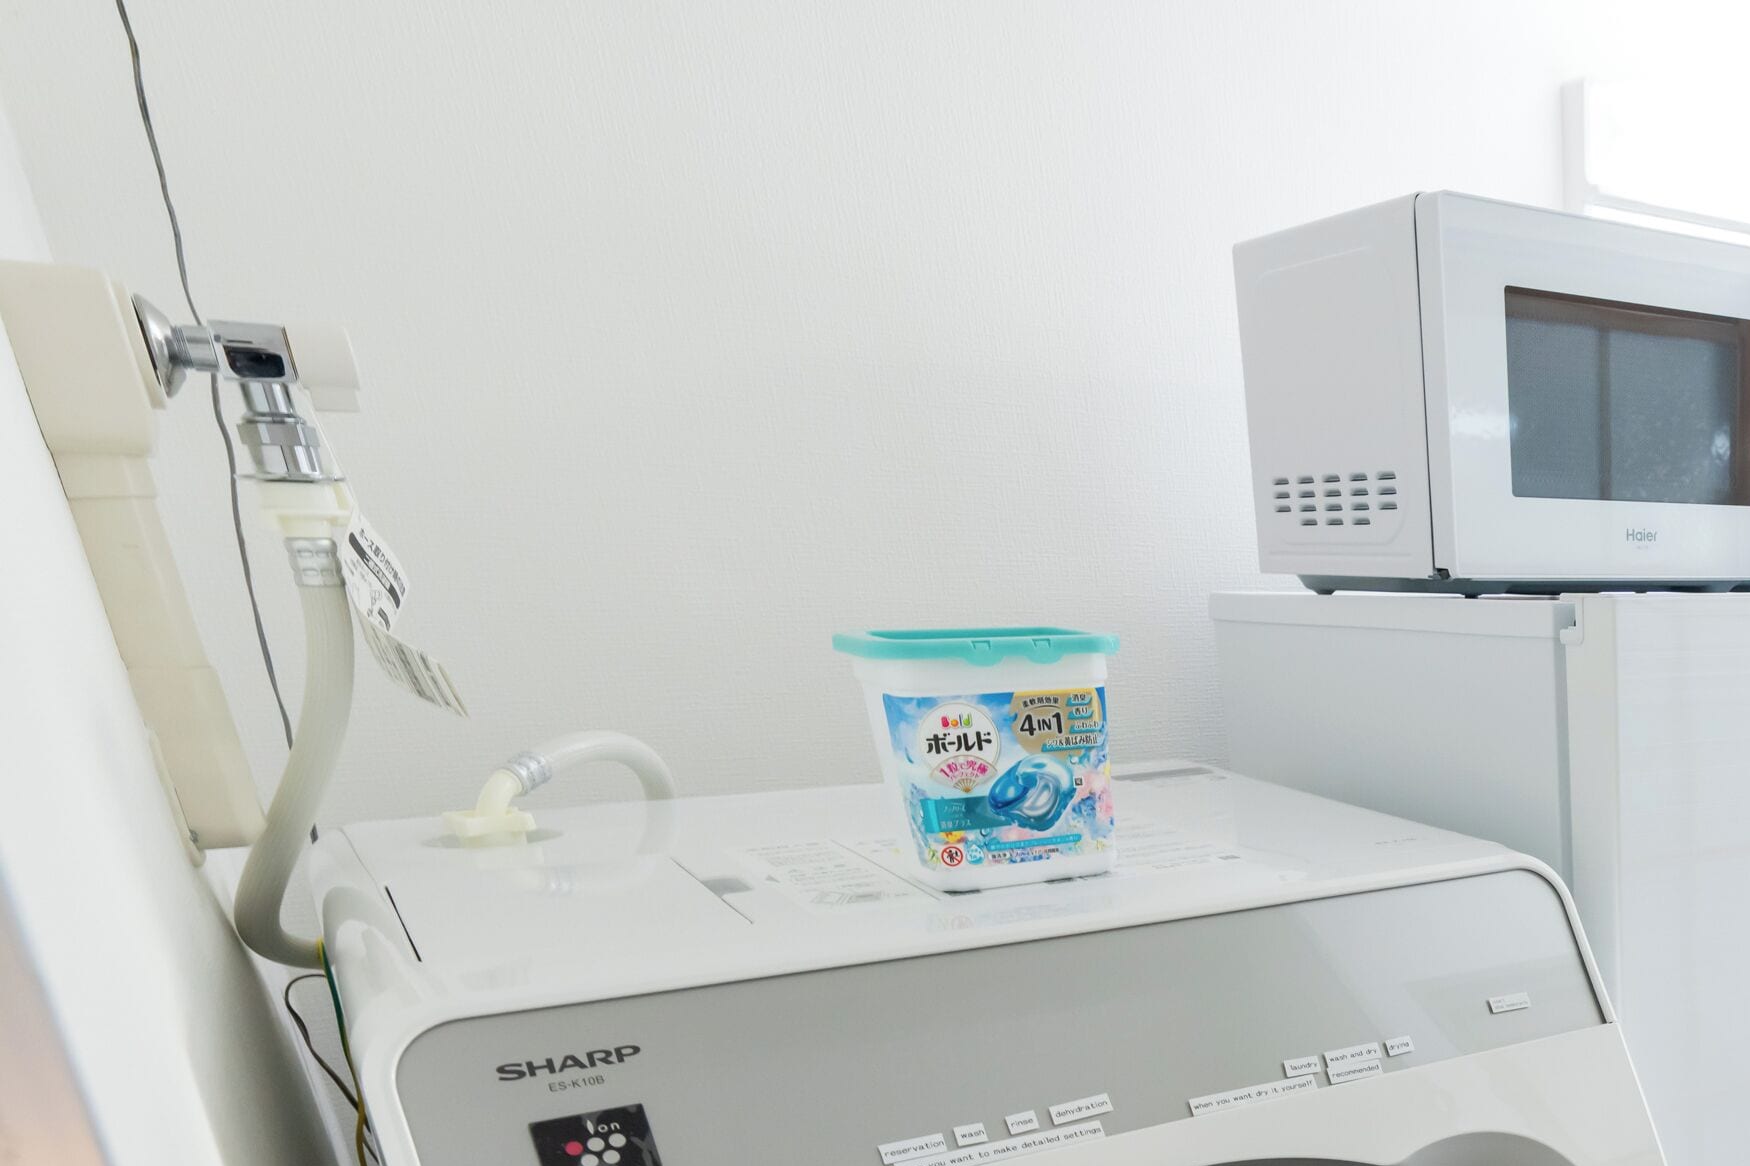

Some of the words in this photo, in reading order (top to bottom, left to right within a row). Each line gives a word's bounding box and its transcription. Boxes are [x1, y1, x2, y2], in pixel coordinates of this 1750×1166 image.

[1626, 528, 1658, 542] Haier
[926, 731, 993, 755] ボールド
[496, 1045, 642, 1081] SHARP
[1329, 1054, 1348, 1062] wash
[1350, 1050, 1364, 1058] and
[1365, 1048, 1378, 1056] dry
[1290, 1061, 1318, 1071] laundry
[548, 1075, 606, 1092] ES-K10B
[1194, 1101, 1213, 1111] when
[1216, 1097, 1231, 1106] you
[1233, 1092, 1253, 1101] want
[1255, 1089, 1269, 1097] dry
[1055, 1099, 1108, 1119] dehydration
[586, 1119, 621, 1136] Ion
[1010, 1117, 1034, 1128] rinse
[960, 1128, 986, 1140] wash
[884, 1138, 945, 1158] reservation
[950, 1153, 975, 1165] want
[978, 1149, 991, 1158] to
[993, 1144, 1018, 1156] make
[1021, 1135, 1061, 1150] detailed
[1063, 1126, 1103, 1142] settings
